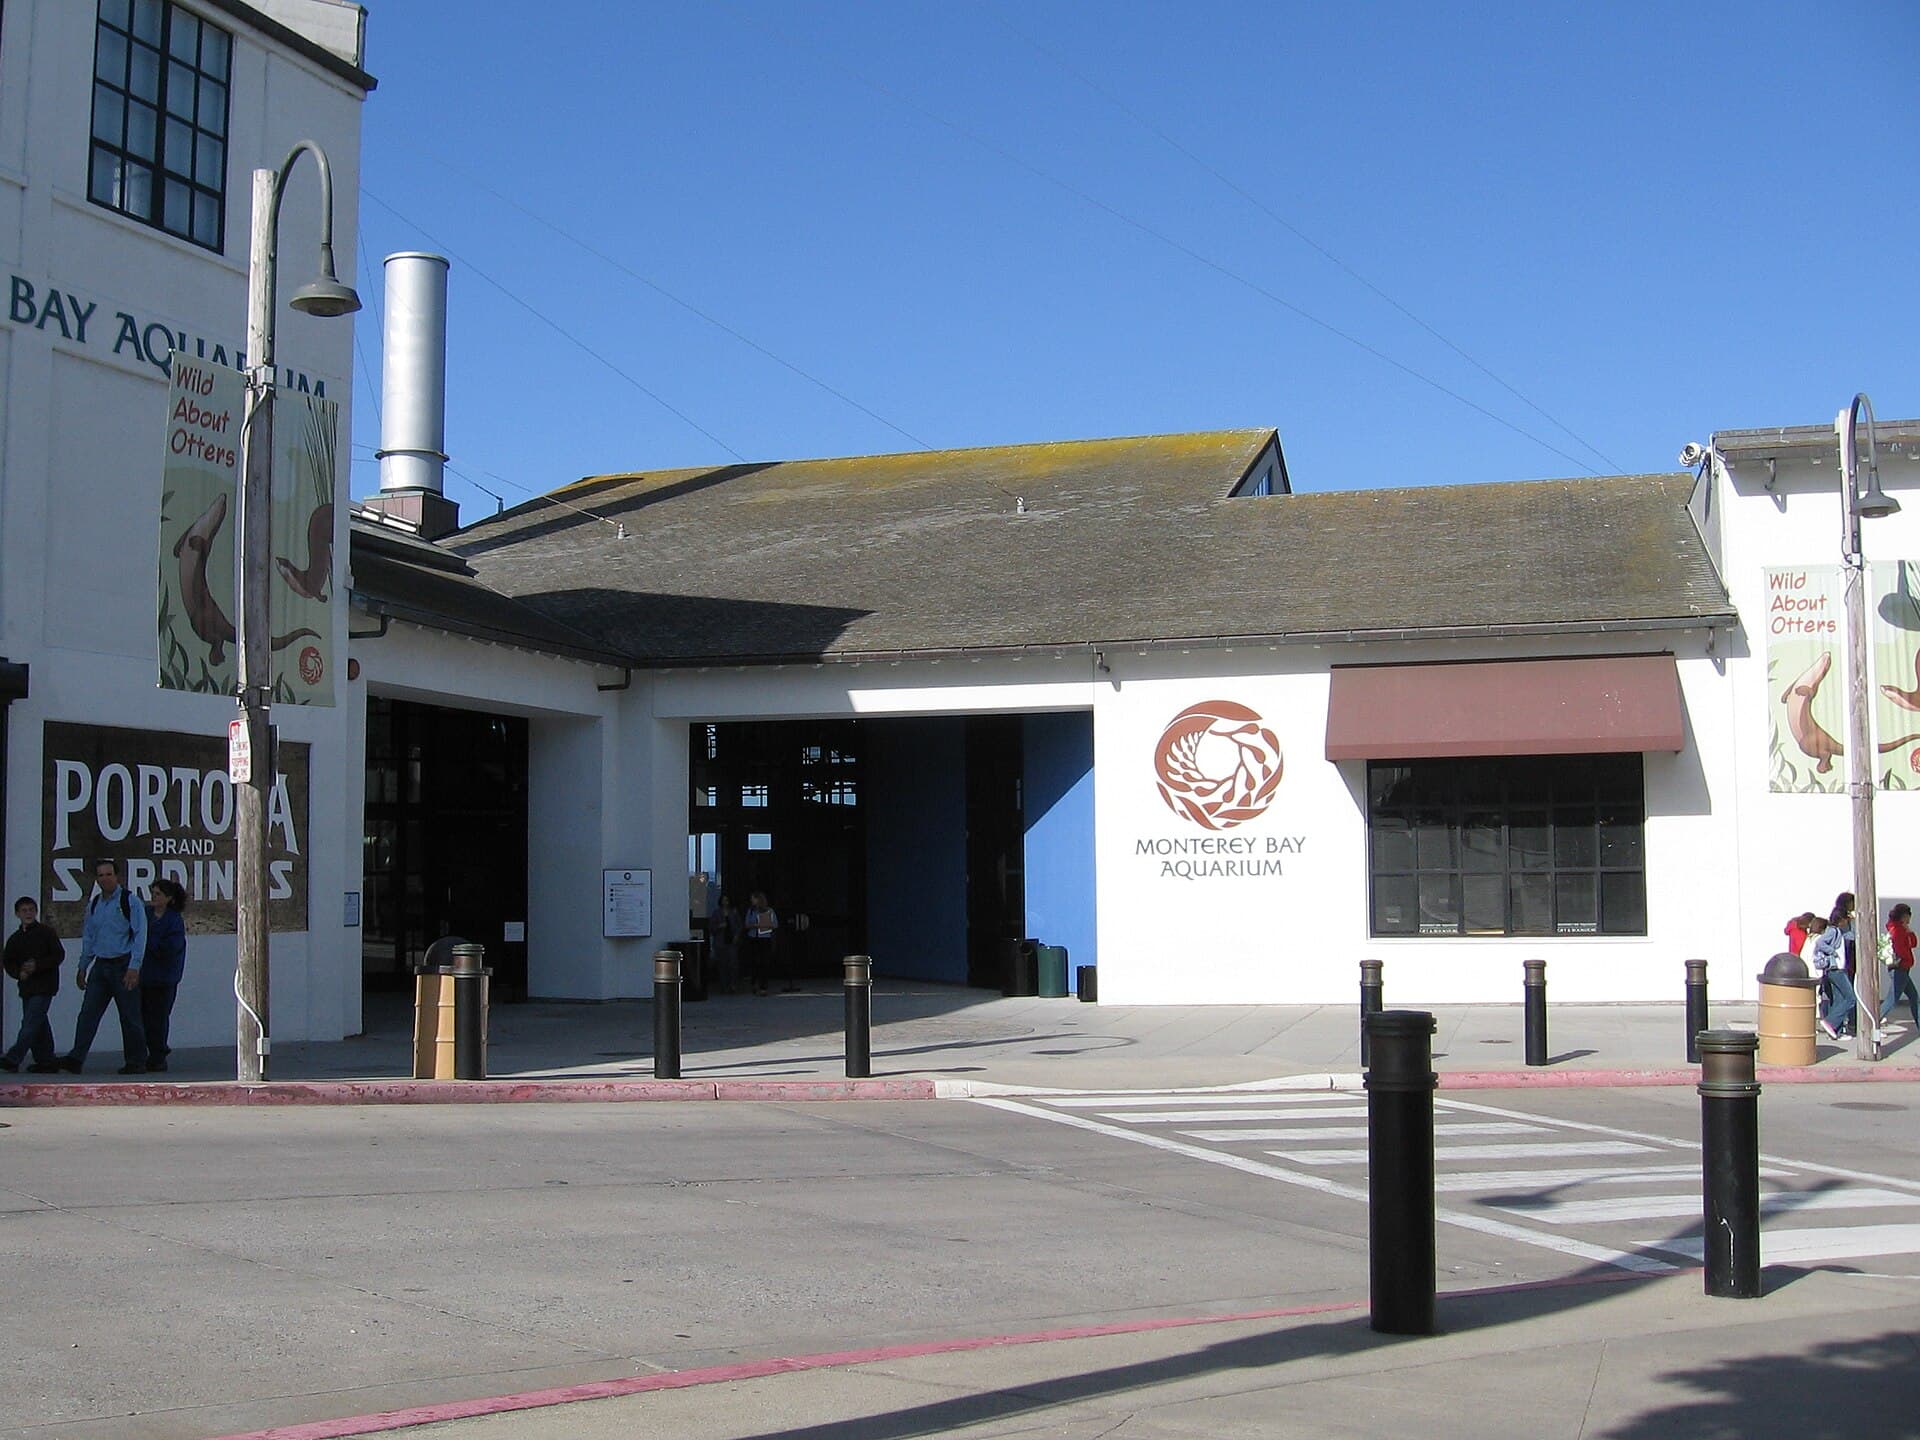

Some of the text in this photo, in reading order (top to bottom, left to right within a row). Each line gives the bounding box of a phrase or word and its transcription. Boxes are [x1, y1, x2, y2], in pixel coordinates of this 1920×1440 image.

[9, 274, 326, 398] BAY AQAM
[176, 362, 215, 396] Wild
[172, 396, 231, 433] About
[170, 427, 236, 468] Otters
[1770, 572, 1806, 590] Wild
[1771, 594, 1827, 612] About
[1772, 616, 1836, 634] Otters
[52, 758, 300, 856] PORTOA
[152, 837, 215, 856] BRAND
[1136, 837, 1306, 855] MONTEREY BAY
[52, 857, 294, 902] SRDINS
[1161, 860, 1282, 880] AQUARIUM
